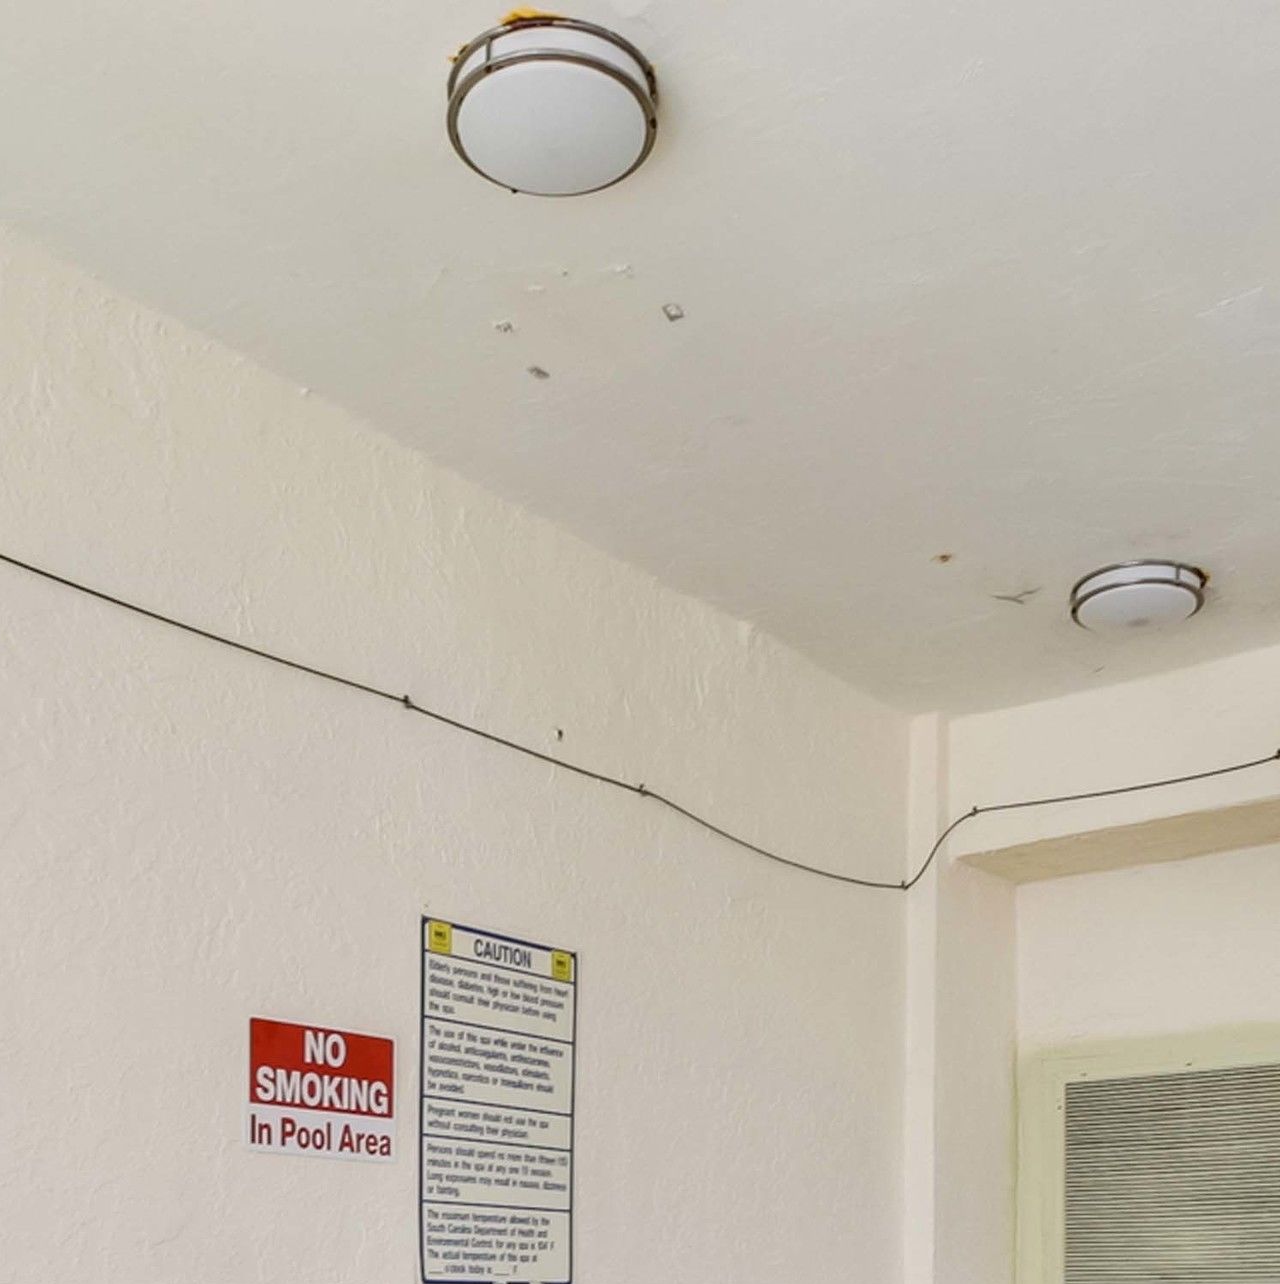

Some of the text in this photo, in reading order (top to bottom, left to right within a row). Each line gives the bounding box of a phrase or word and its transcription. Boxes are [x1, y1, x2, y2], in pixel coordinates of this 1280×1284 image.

[474, 939, 531, 968] CAUTION
[304, 1030, 346, 1068] NO
[256, 1065, 389, 1114] SMOKING
[250, 1114, 391, 1156] In Pool Area
